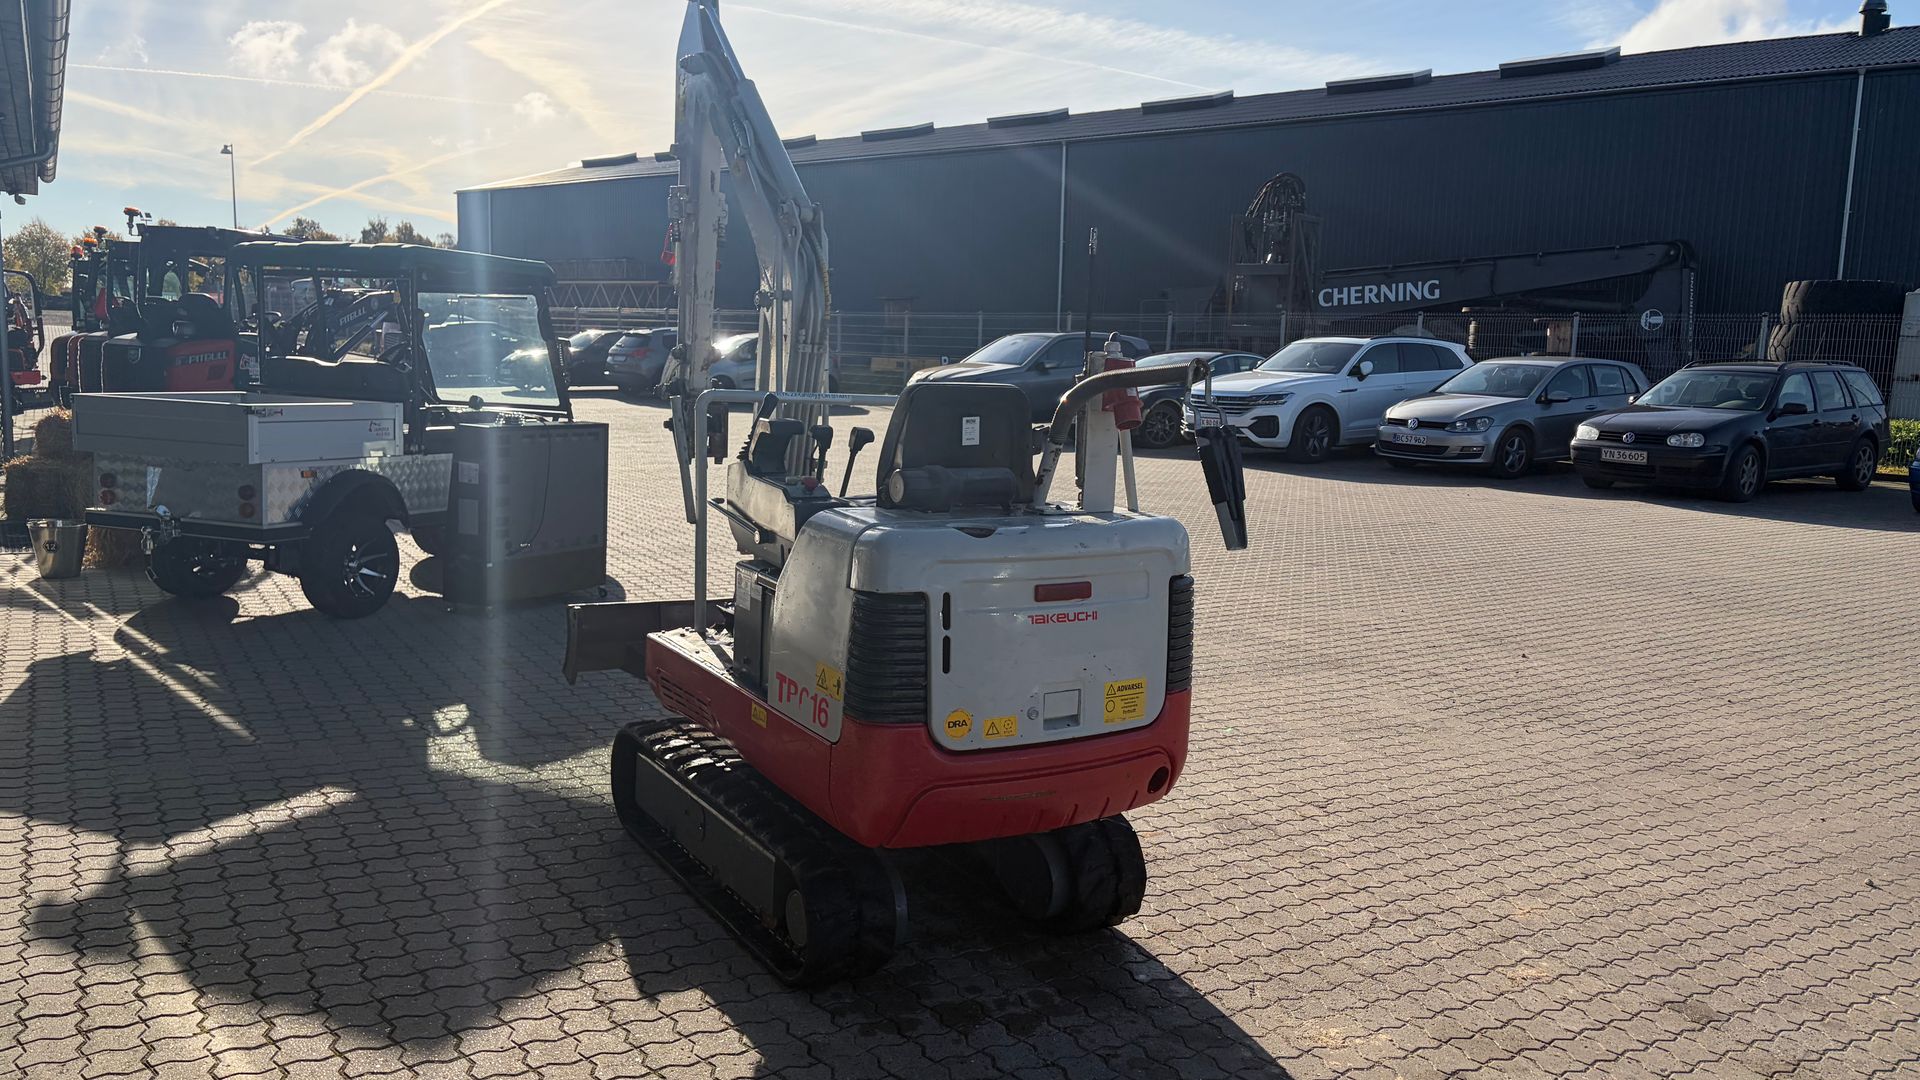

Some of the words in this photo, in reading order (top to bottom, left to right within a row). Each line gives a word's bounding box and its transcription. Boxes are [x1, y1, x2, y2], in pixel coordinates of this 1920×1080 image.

[1318, 280, 1440, 307] CHERNING
[1603, 450, 1615, 458] YN
[1616, 451, 1627, 460] 36
[1628, 452, 1645, 461] 605
[1027, 611, 1098, 625] TAKEUCHI
[1117, 682, 1144, 692] ADVARSEL
[948, 720, 968, 729] DRA
